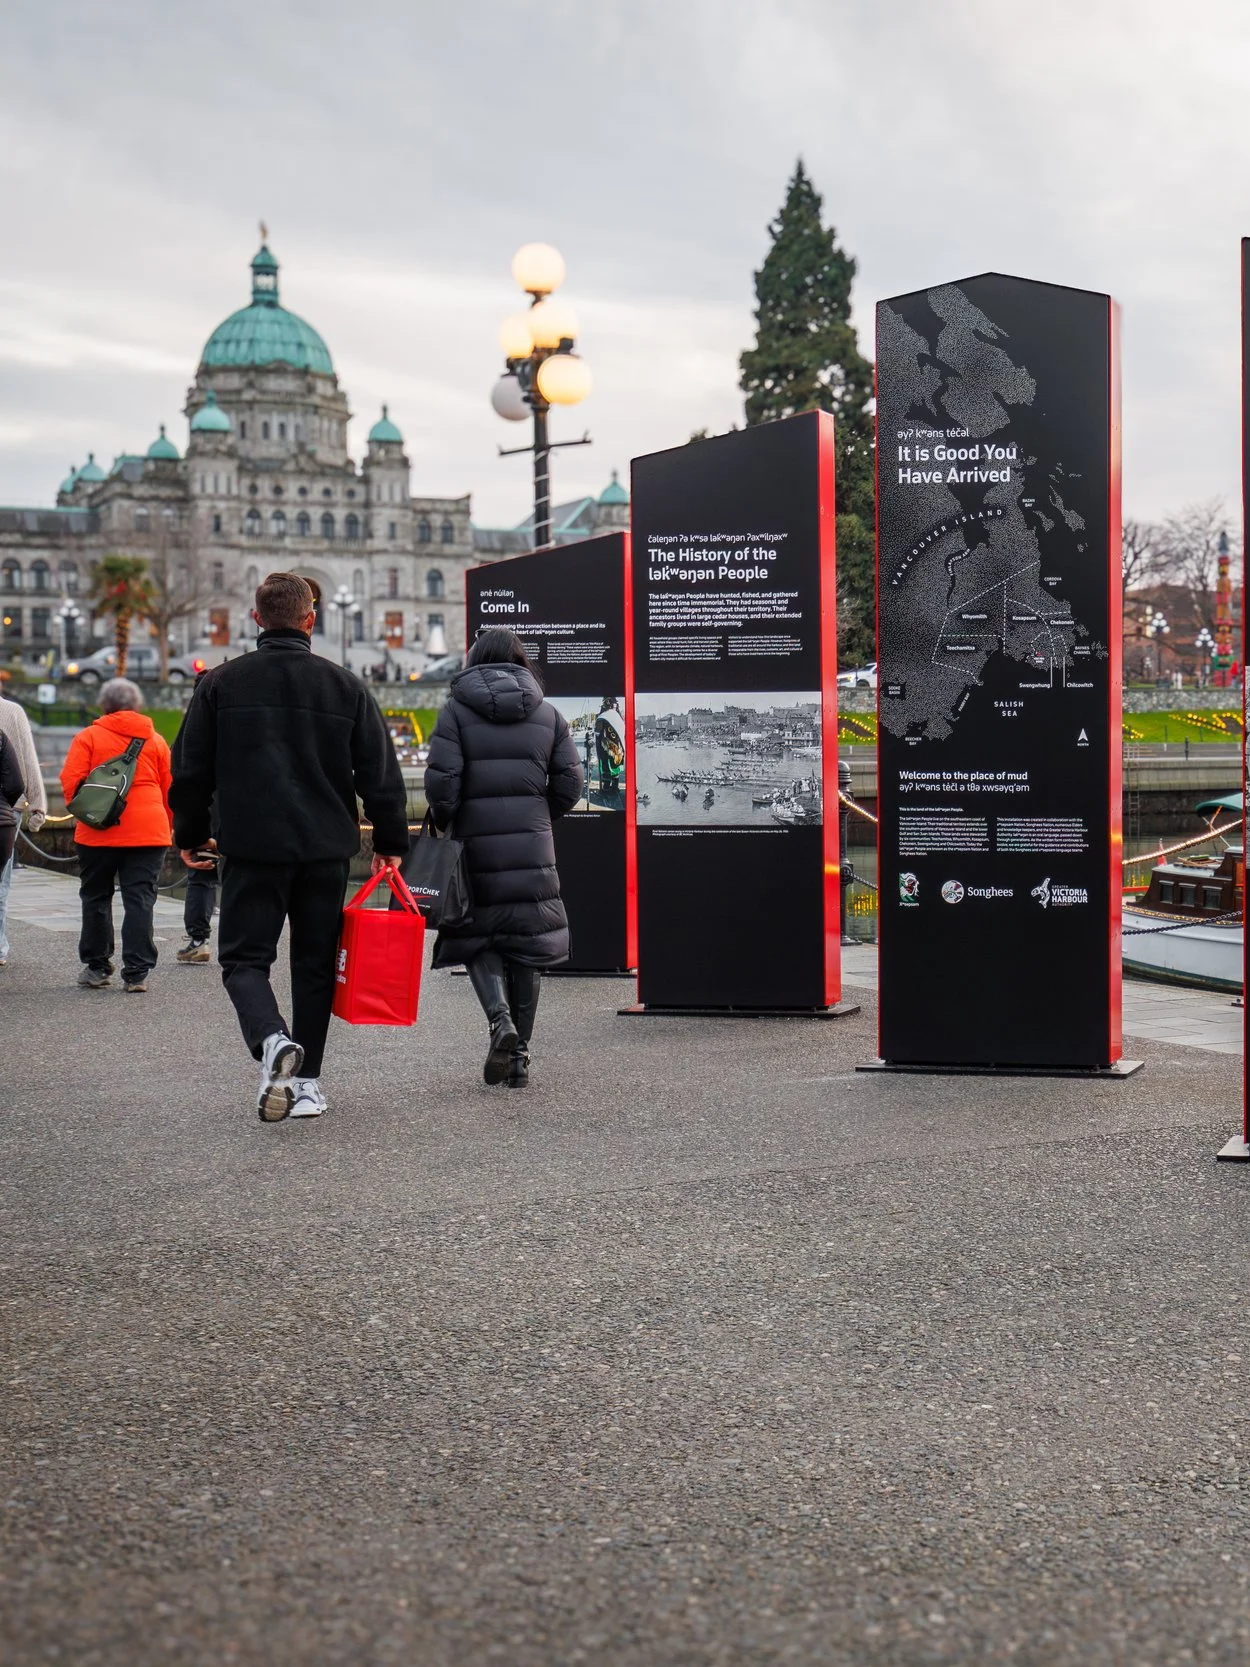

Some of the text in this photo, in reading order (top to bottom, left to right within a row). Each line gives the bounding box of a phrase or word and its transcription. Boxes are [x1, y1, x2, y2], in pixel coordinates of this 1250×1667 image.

[898, 444, 1017, 461] It is Good You
[899, 466, 1010, 484] Have Arrived
[892, 508, 1004, 586] VANCOUVER ISLAND
[648, 547, 777, 564] The History of the
[719, 566, 767, 582] People
[480, 601, 529, 613] Come In
[899, 771, 1028, 782] Welcome to the place of mud
[967, 887, 1014, 899] Songhees
